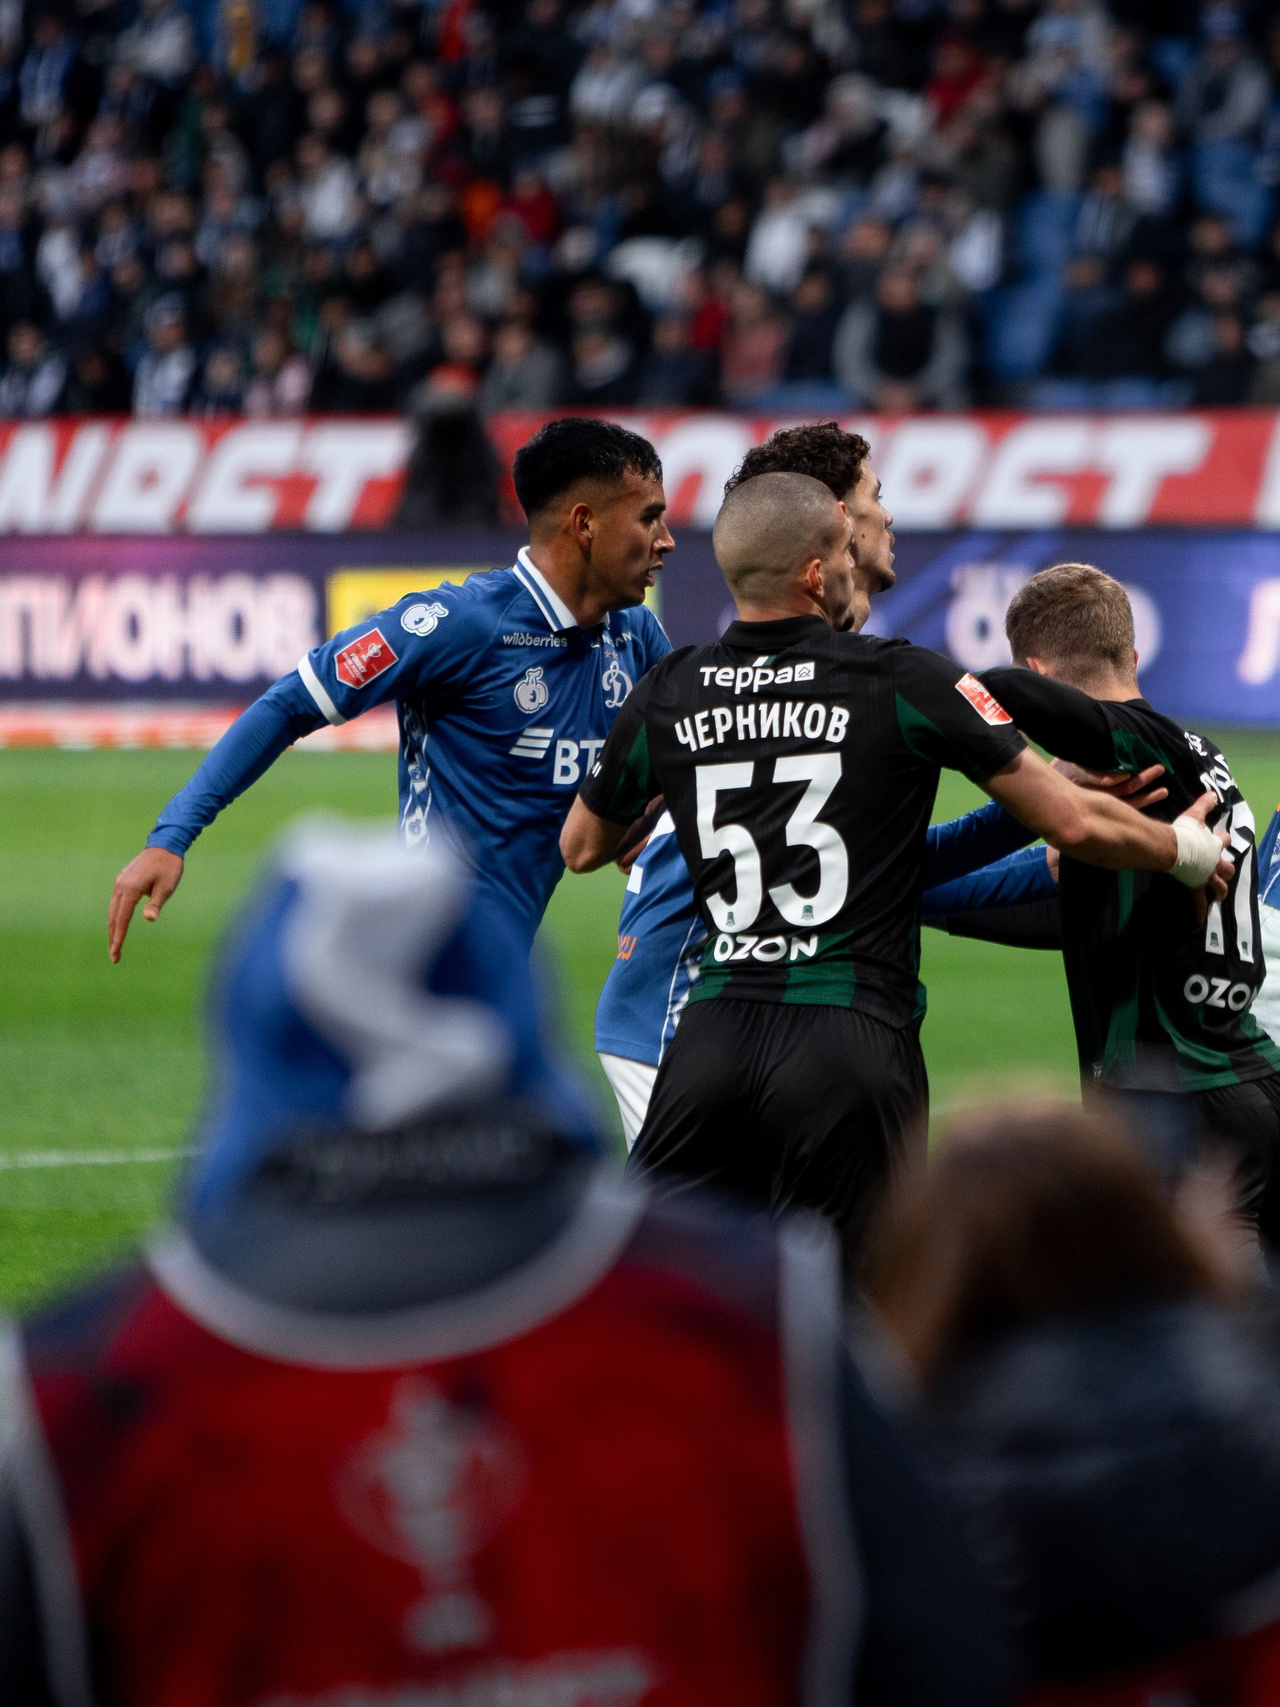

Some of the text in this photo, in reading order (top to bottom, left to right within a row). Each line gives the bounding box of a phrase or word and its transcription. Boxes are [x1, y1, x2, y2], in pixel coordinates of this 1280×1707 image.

[503, 632, 568, 648] wildberries
[673, 701, 850, 752] ЧЕРНИКОВ
[695, 752, 849, 934] 53
[713, 934, 819, 963] OZON
